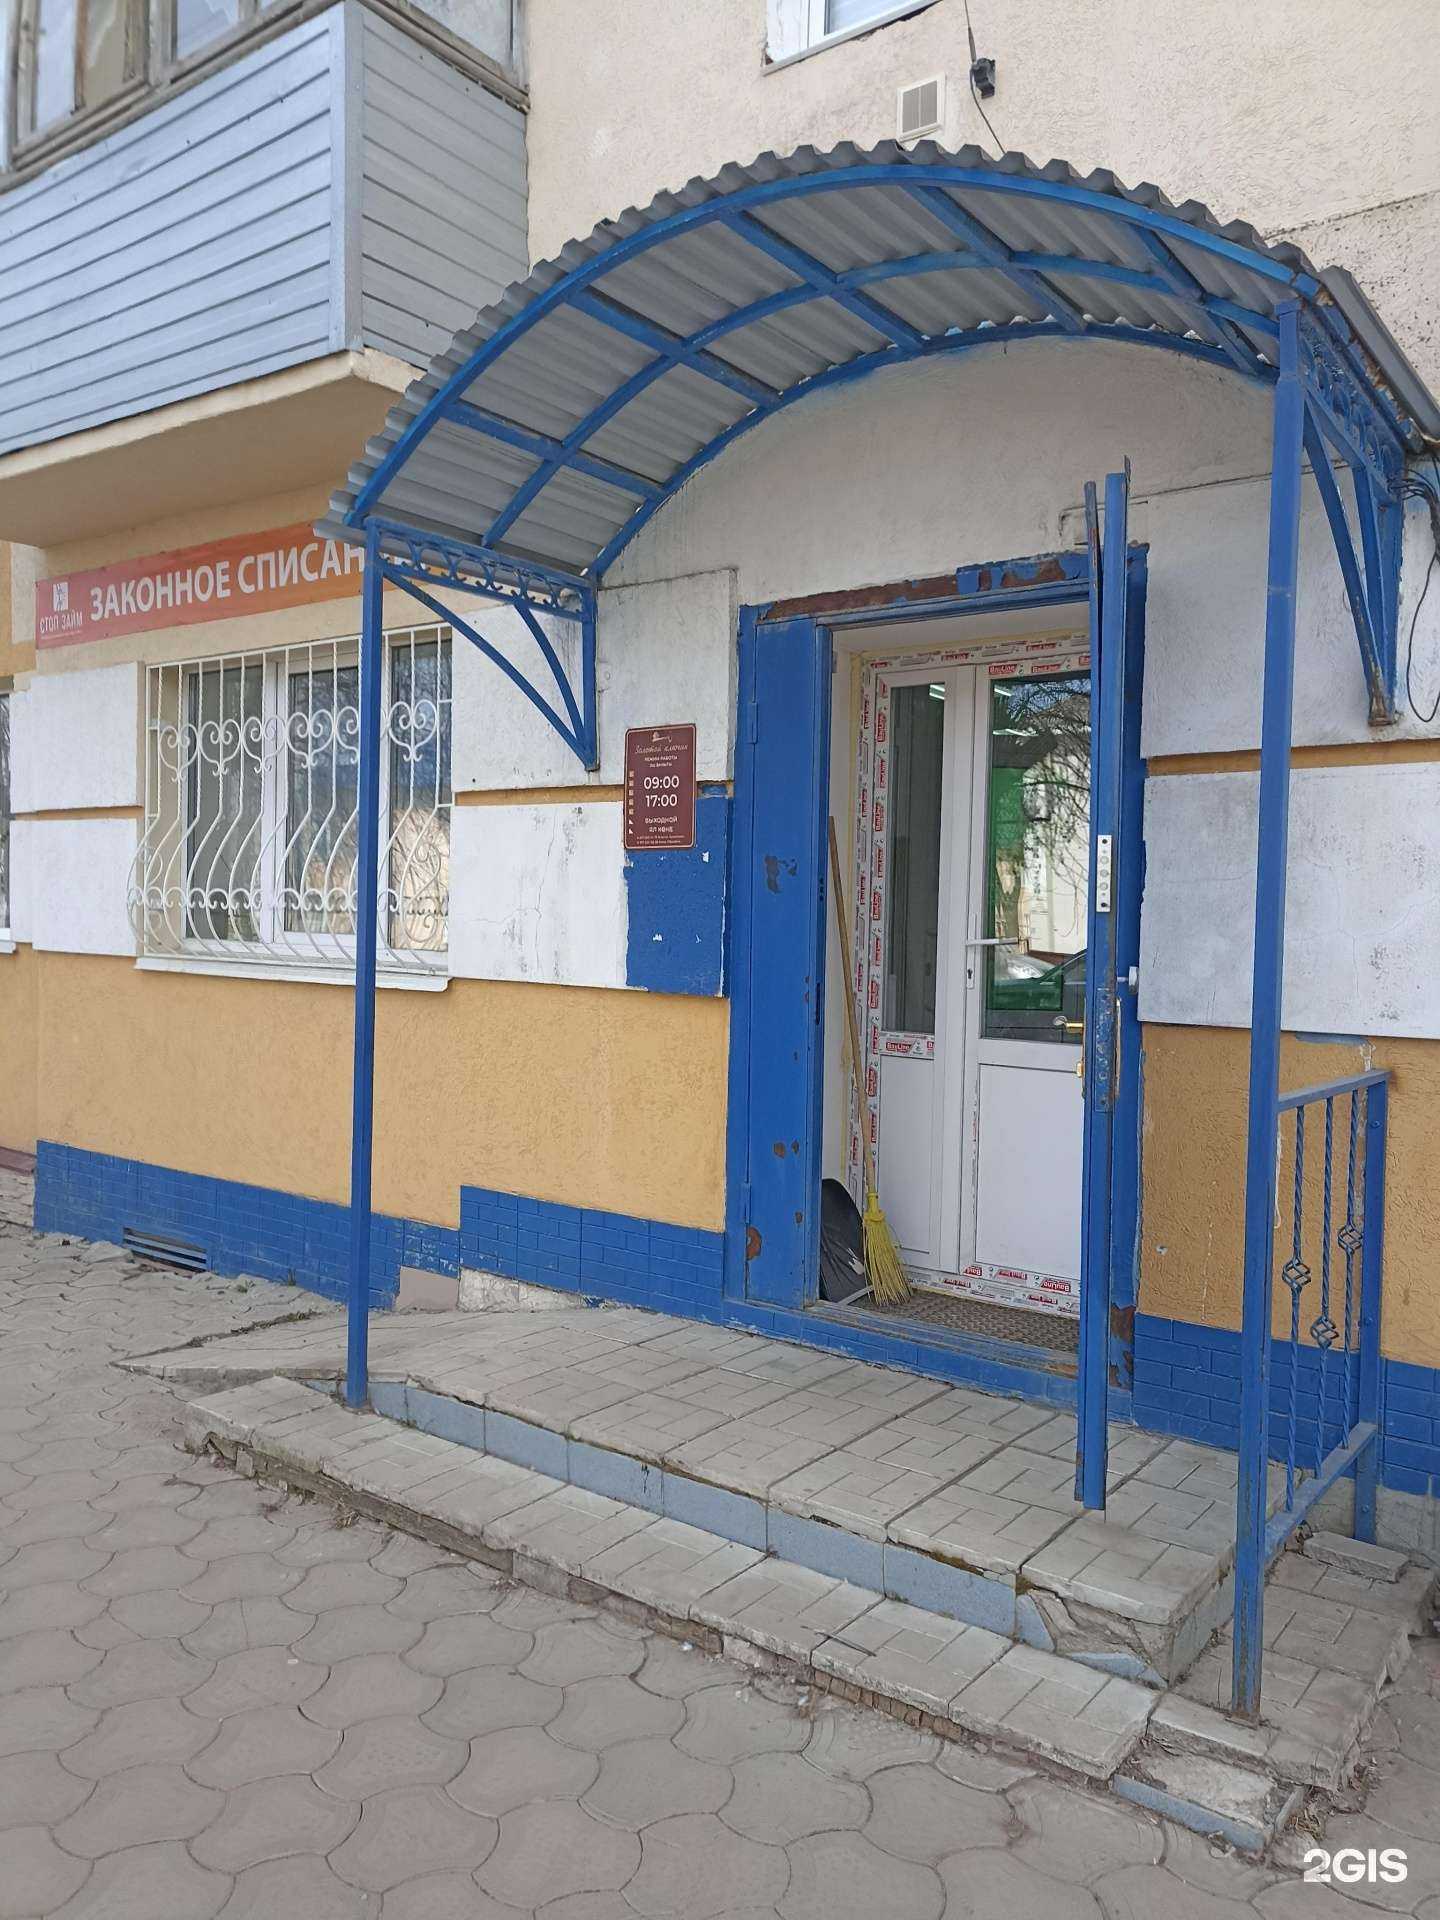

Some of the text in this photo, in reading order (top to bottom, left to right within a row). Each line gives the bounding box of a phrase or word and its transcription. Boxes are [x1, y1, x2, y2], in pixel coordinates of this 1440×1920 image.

[90, 560, 231, 621] ЗАКОННОЕ
[40, 609, 83, 634] СТОП ЗАЙМ
[643, 775, 680, 790] 09:00
[645, 794, 678, 808] 17:00
